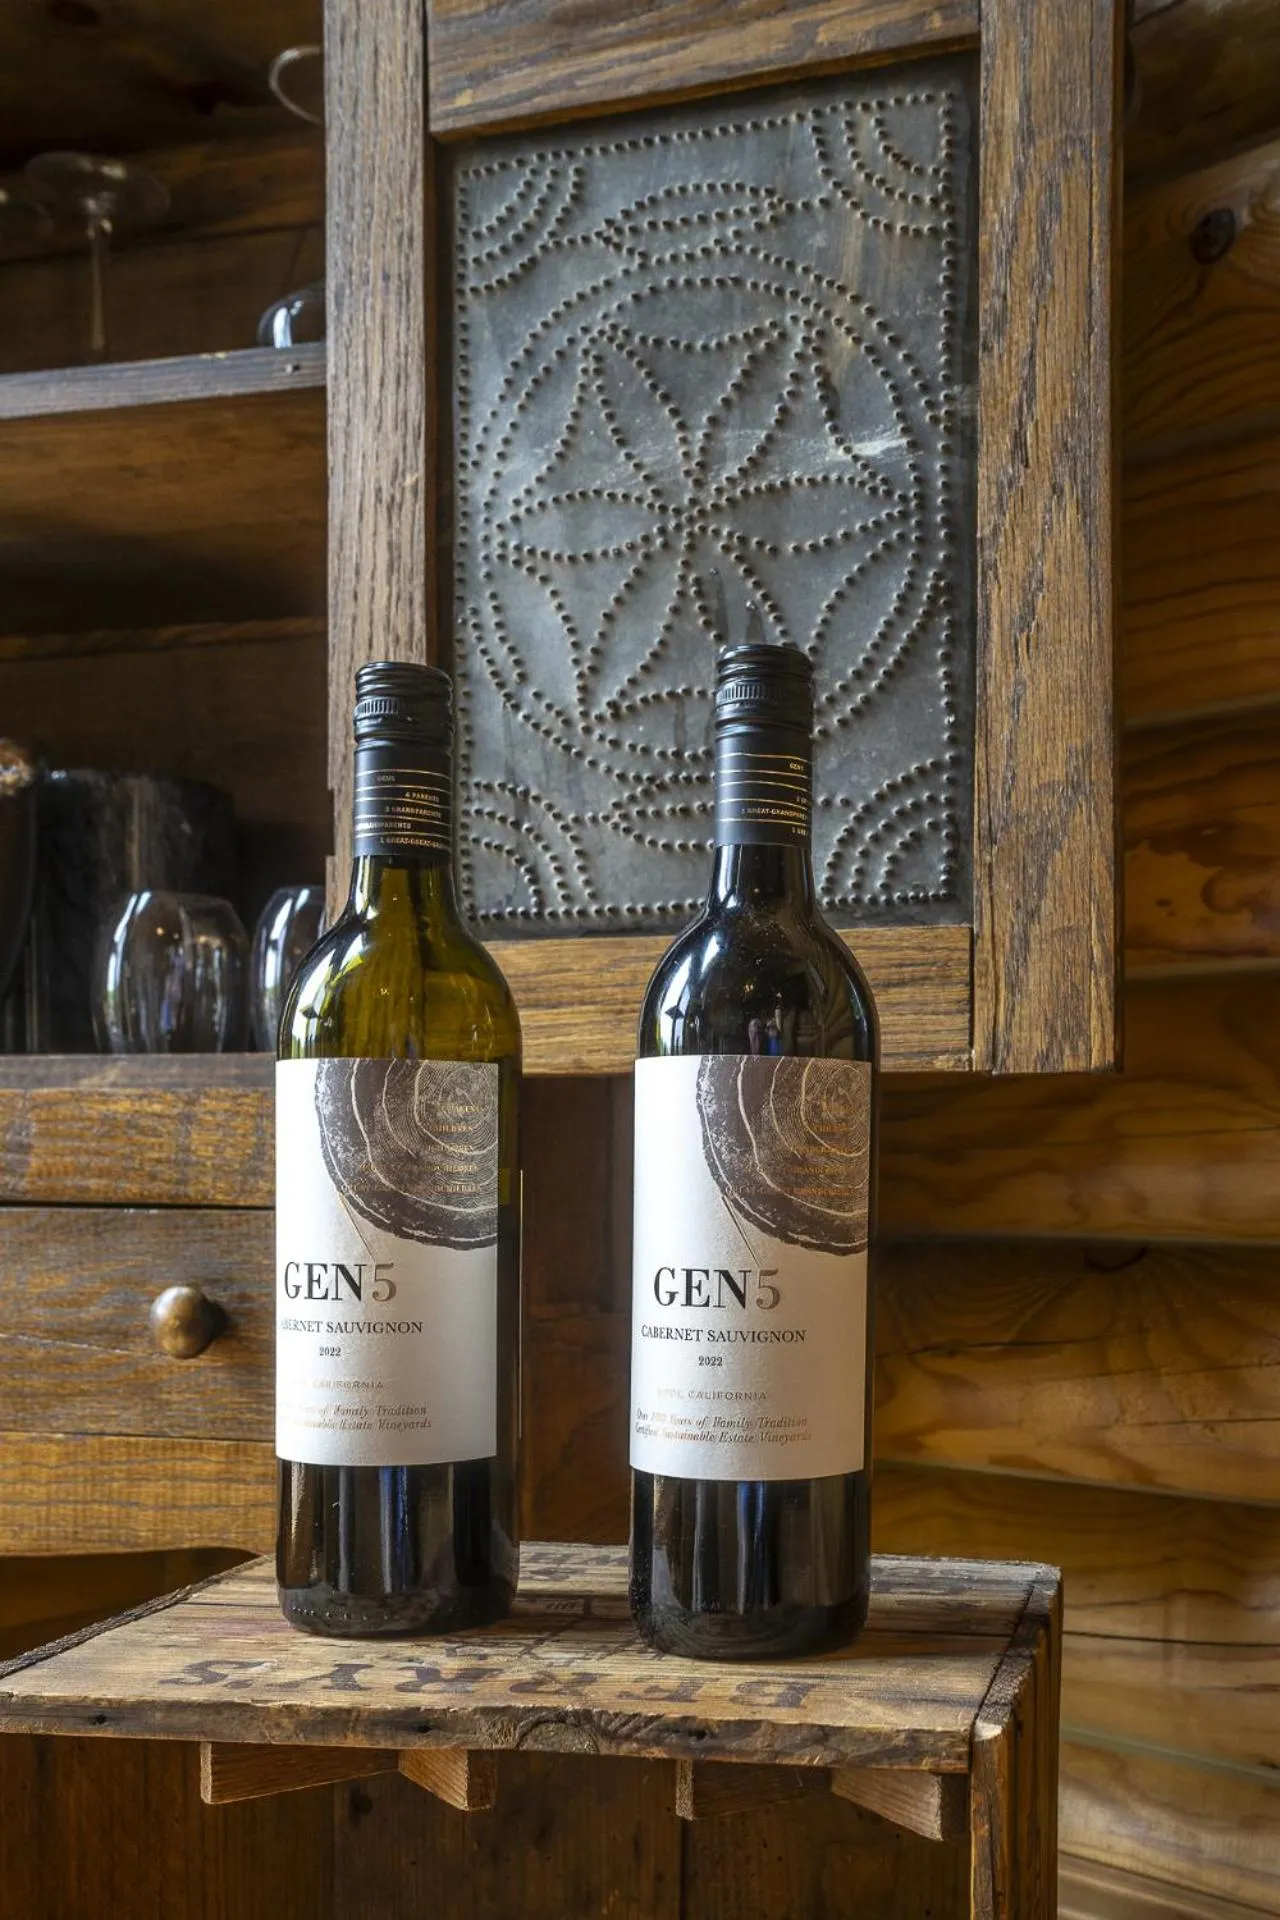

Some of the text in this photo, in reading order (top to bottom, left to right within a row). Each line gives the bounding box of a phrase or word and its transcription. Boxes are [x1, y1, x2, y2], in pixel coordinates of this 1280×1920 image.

[284, 1261, 397, 1302] GEN5
[653, 1266, 781, 1310] GEN5
[326, 1321, 424, 1335] SAUVIGNON
[641, 1323, 807, 1343] CABERNET SAUVIGNON
[319, 1346, 342, 1357] 2022
[698, 1355, 723, 1367] 2022
[688, 1389, 768, 1401] CALIFORNIA
[375, 1404, 428, 1417] Tradition
[377, 1417, 433, 1433] Vineyards
[712, 1416, 752, 1432] Family
[757, 1416, 808, 1429] Tradition
[719, 1431, 754, 1445] Estate
[759, 1429, 813, 1447] Vineyards
[157, 1659, 817, 1709] BERRY'S
